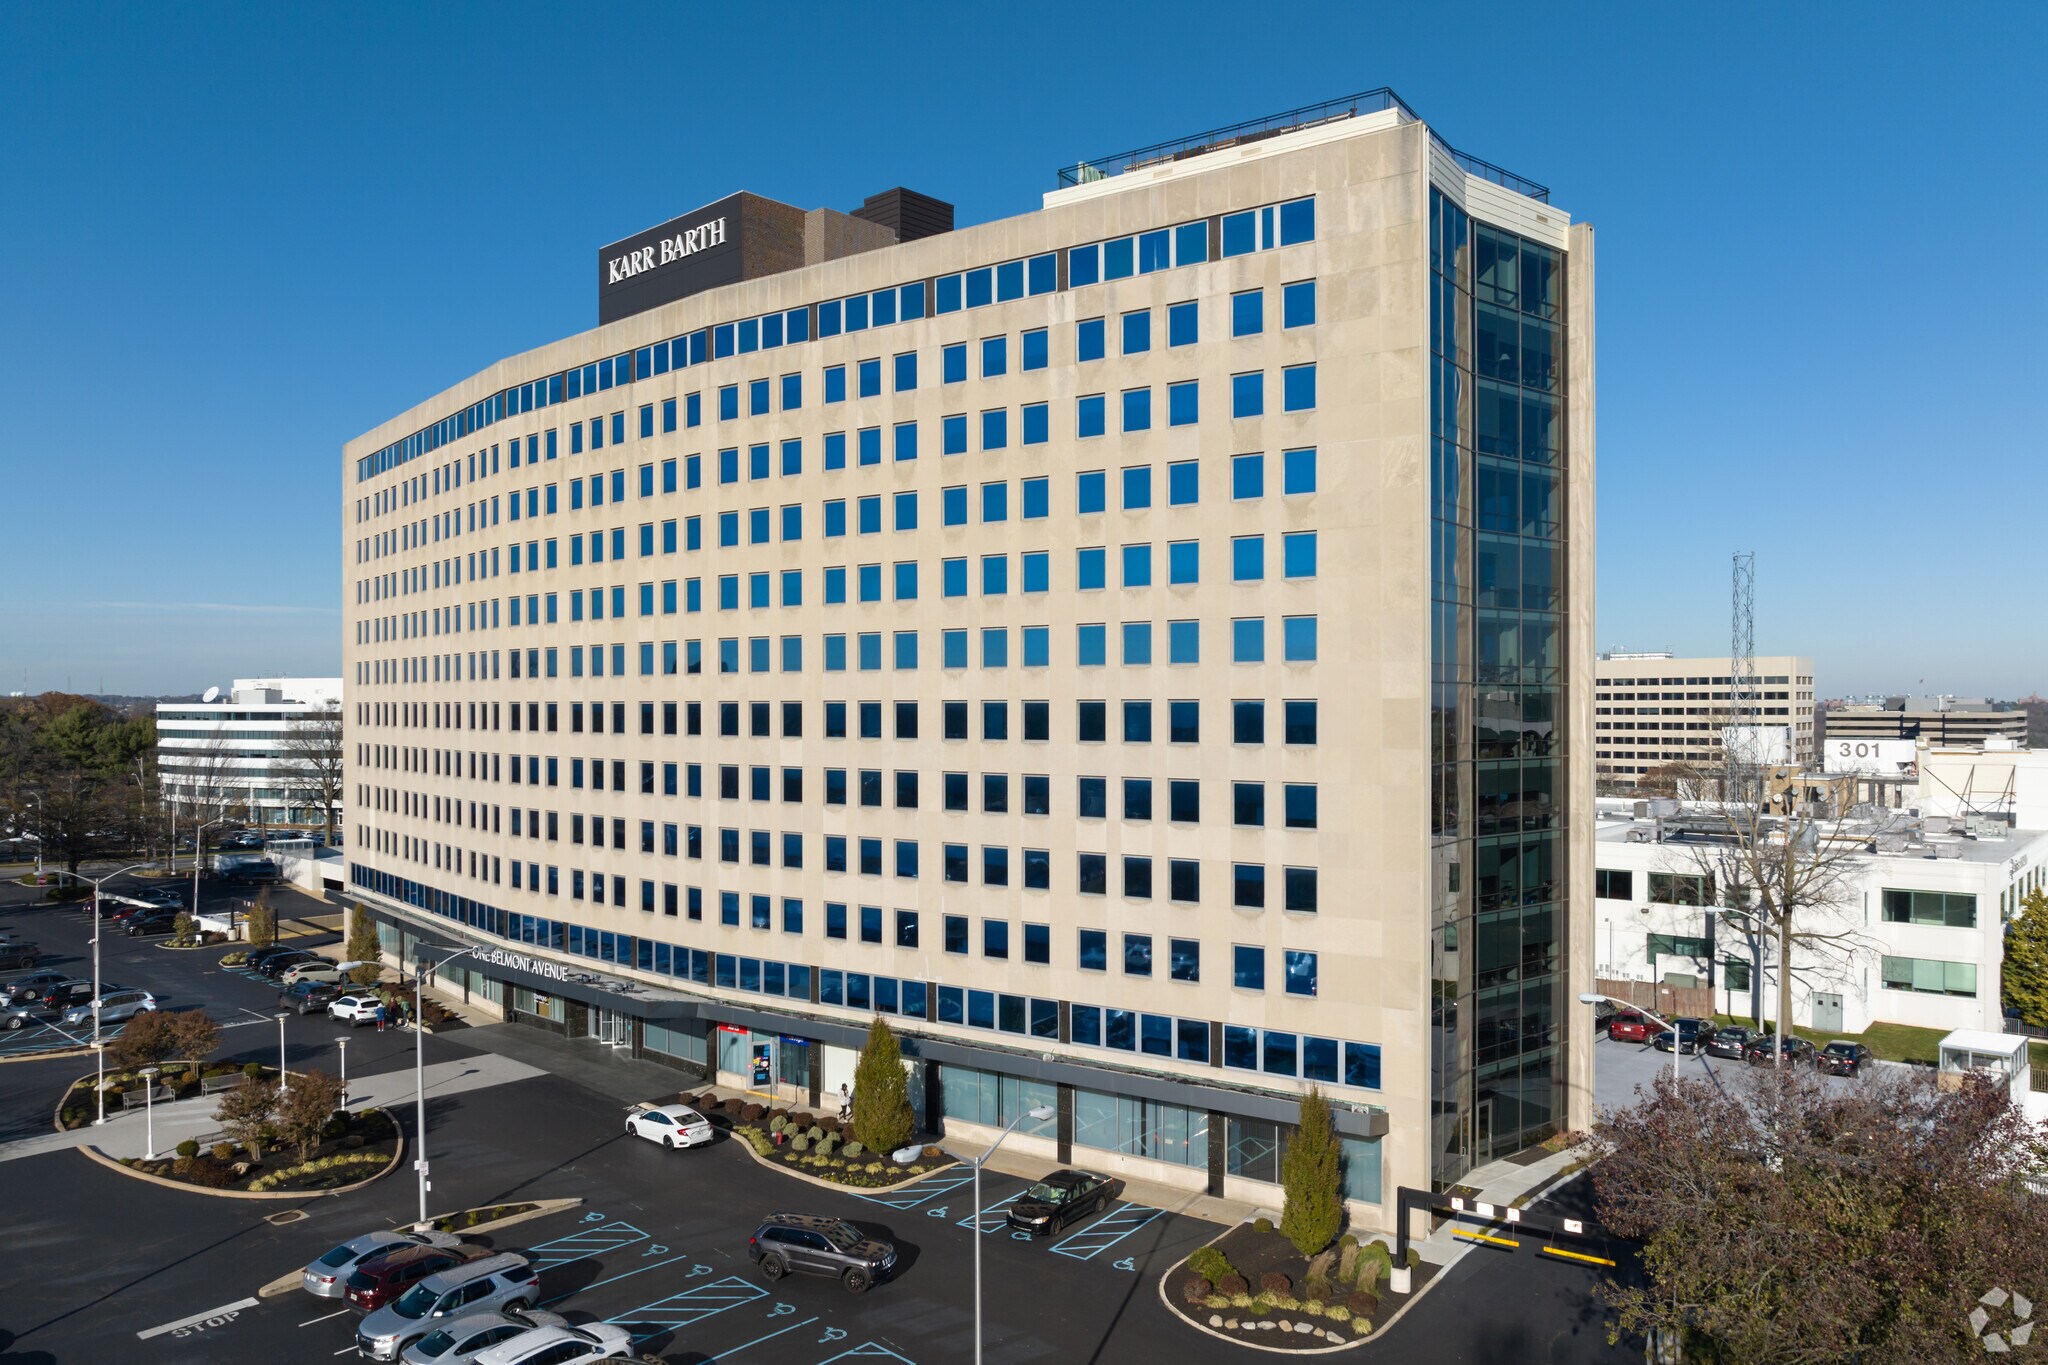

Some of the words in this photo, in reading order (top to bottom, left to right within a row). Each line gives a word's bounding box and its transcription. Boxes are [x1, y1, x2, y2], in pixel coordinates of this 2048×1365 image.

[608, 246, 657, 285] KARR
[659, 216, 728, 266] BARTH
[1839, 742, 1880, 758] 301
[491, 950, 530, 972] BELMONT
[531, 959, 568, 982] AVENUE
[171, 1310, 240, 1338] STOP
